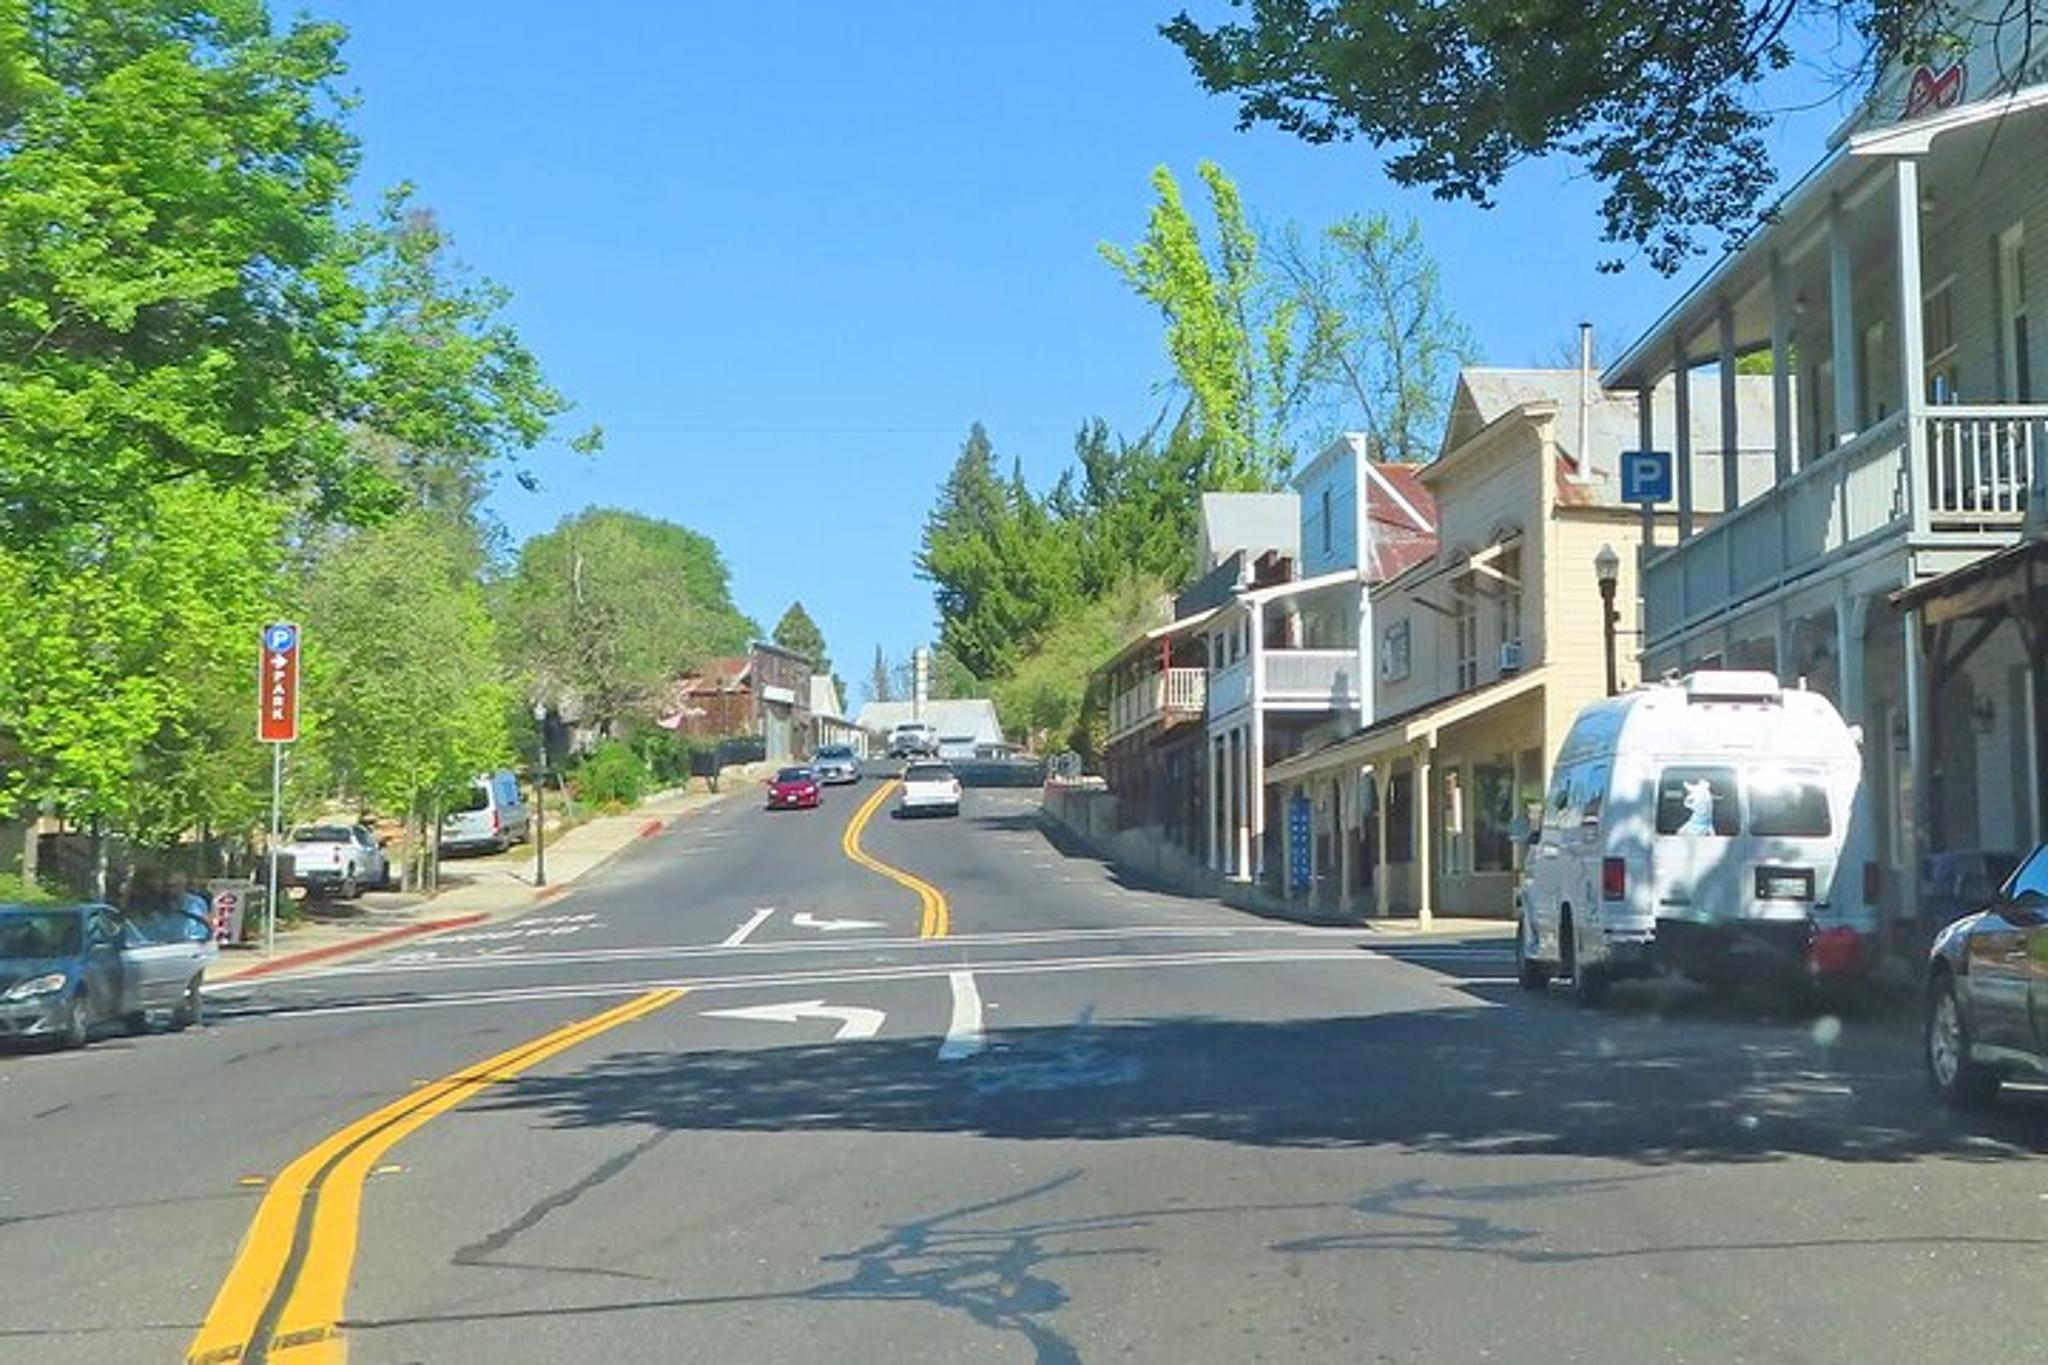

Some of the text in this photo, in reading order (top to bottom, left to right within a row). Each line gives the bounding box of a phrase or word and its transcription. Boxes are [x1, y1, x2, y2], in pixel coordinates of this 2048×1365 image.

[1632, 459, 1662, 493] P
[272, 630, 289, 648] P
[272, 671, 286, 720] PARK
